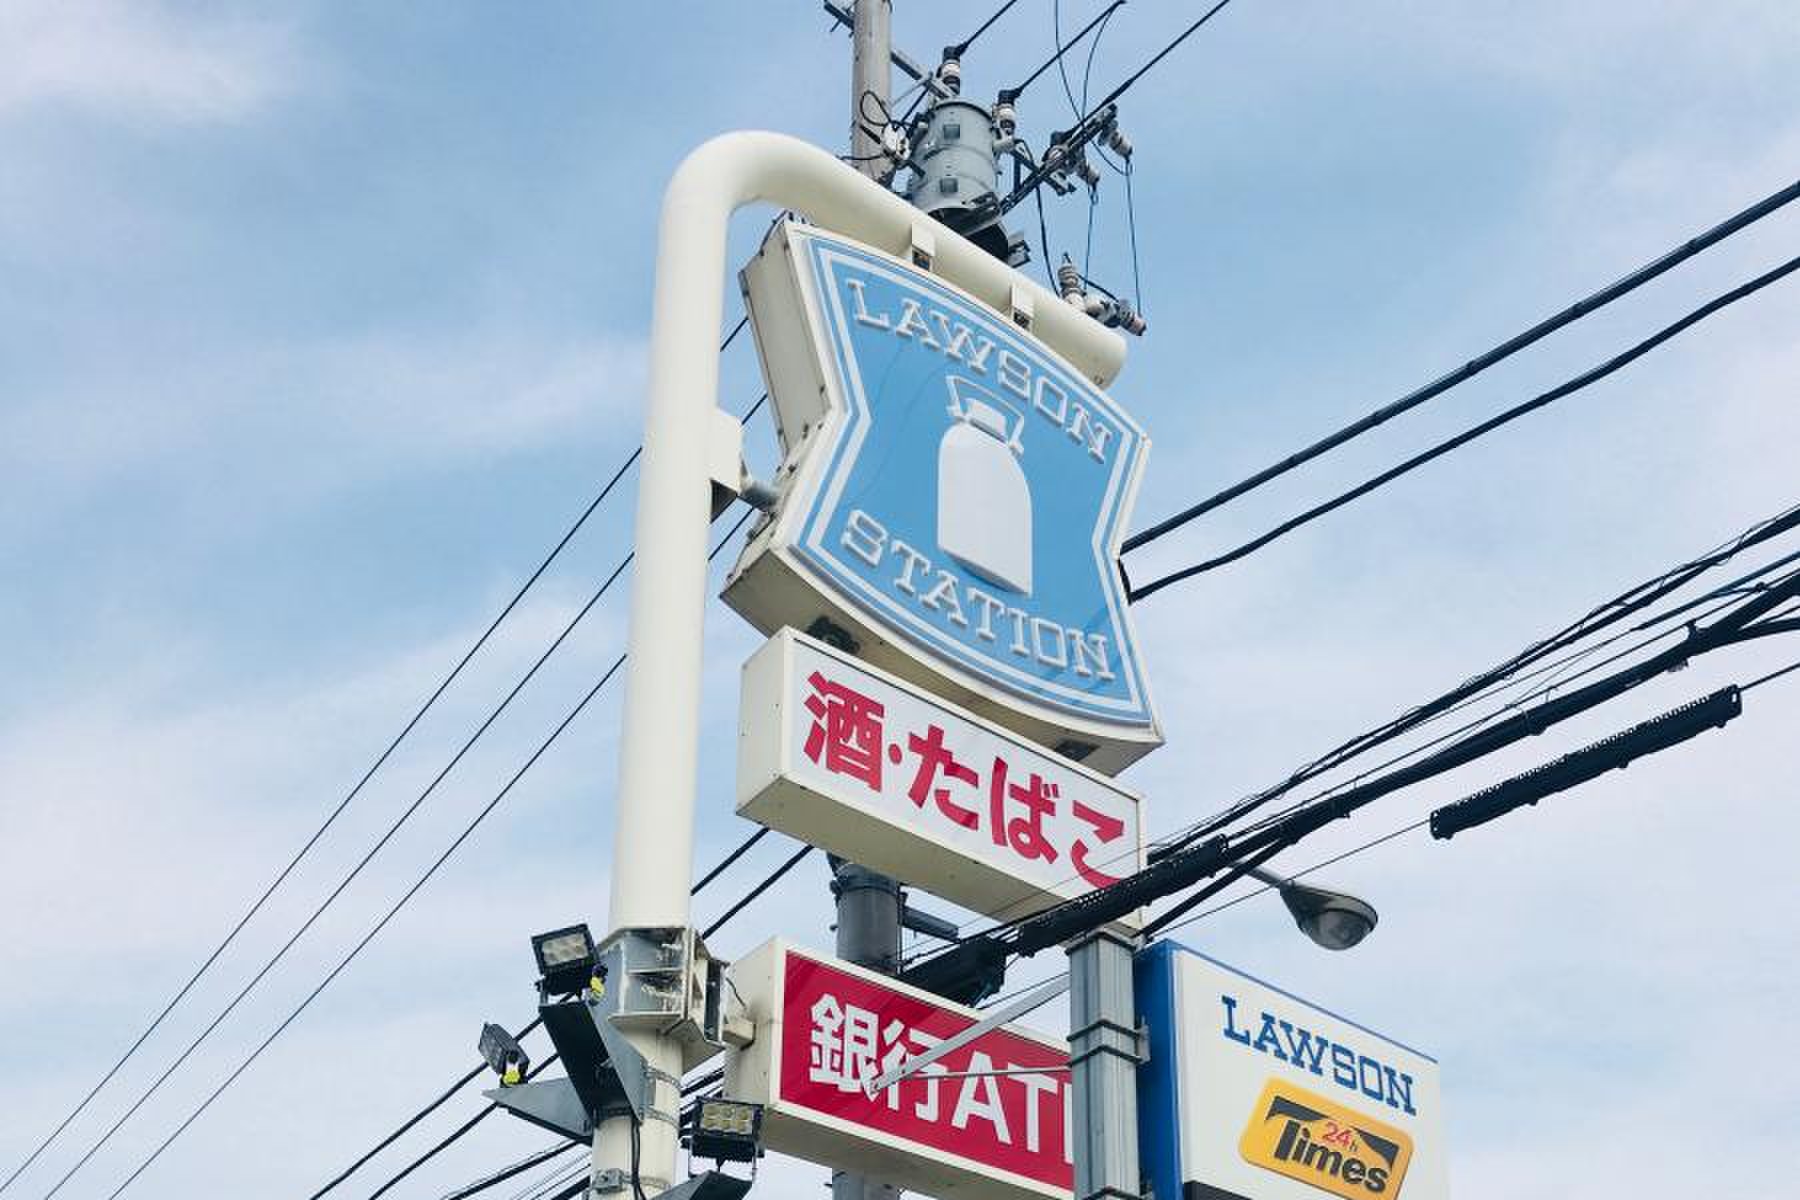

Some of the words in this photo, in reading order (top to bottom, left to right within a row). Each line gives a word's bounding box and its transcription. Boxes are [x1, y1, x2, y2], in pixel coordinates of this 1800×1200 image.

[847, 279, 1112, 464] LAWSON
[840, 509, 1117, 683] STATION
[809, 993, 1073, 1165] 銀行AT
[1221, 994, 1417, 1117] LAWSON
[1265, 1097, 1391, 1194] Times
